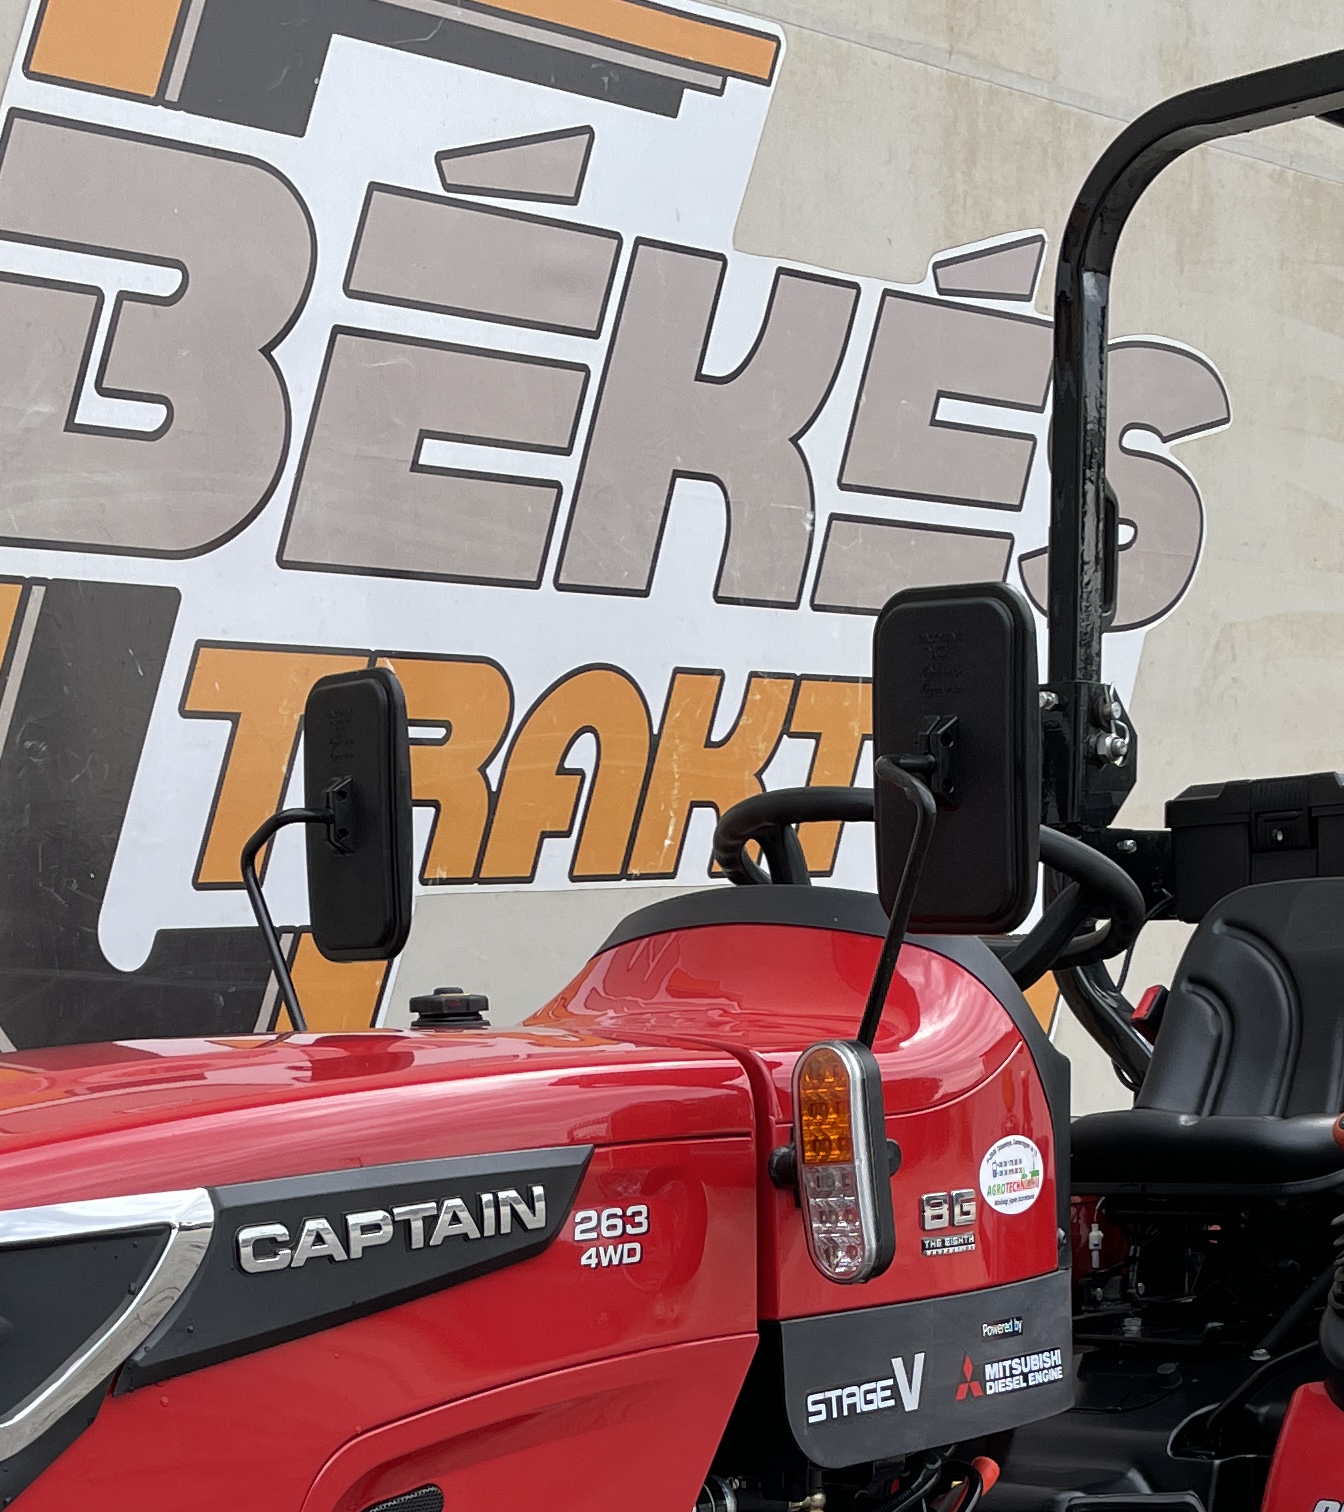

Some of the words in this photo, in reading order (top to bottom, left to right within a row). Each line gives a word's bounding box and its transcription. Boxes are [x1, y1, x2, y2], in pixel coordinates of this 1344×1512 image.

[573, 1204, 649, 1241] 263
[921, 1188, 977, 1231] 8G
[235, 1184, 547, 1275] CAPTAIN
[580, 1243, 643, 1269] 4WD
[982, 1320, 1013, 1338] Powered
[1013, 1317, 1023, 1333] by
[984, 1349, 1062, 1381] MITSUBISHI
[986, 1376, 1027, 1395] DIESEL
[1028, 1366, 1064, 1388] ENGINE
[807, 1378, 896, 1424] STAGE
[891, 1352, 925, 1412] V
